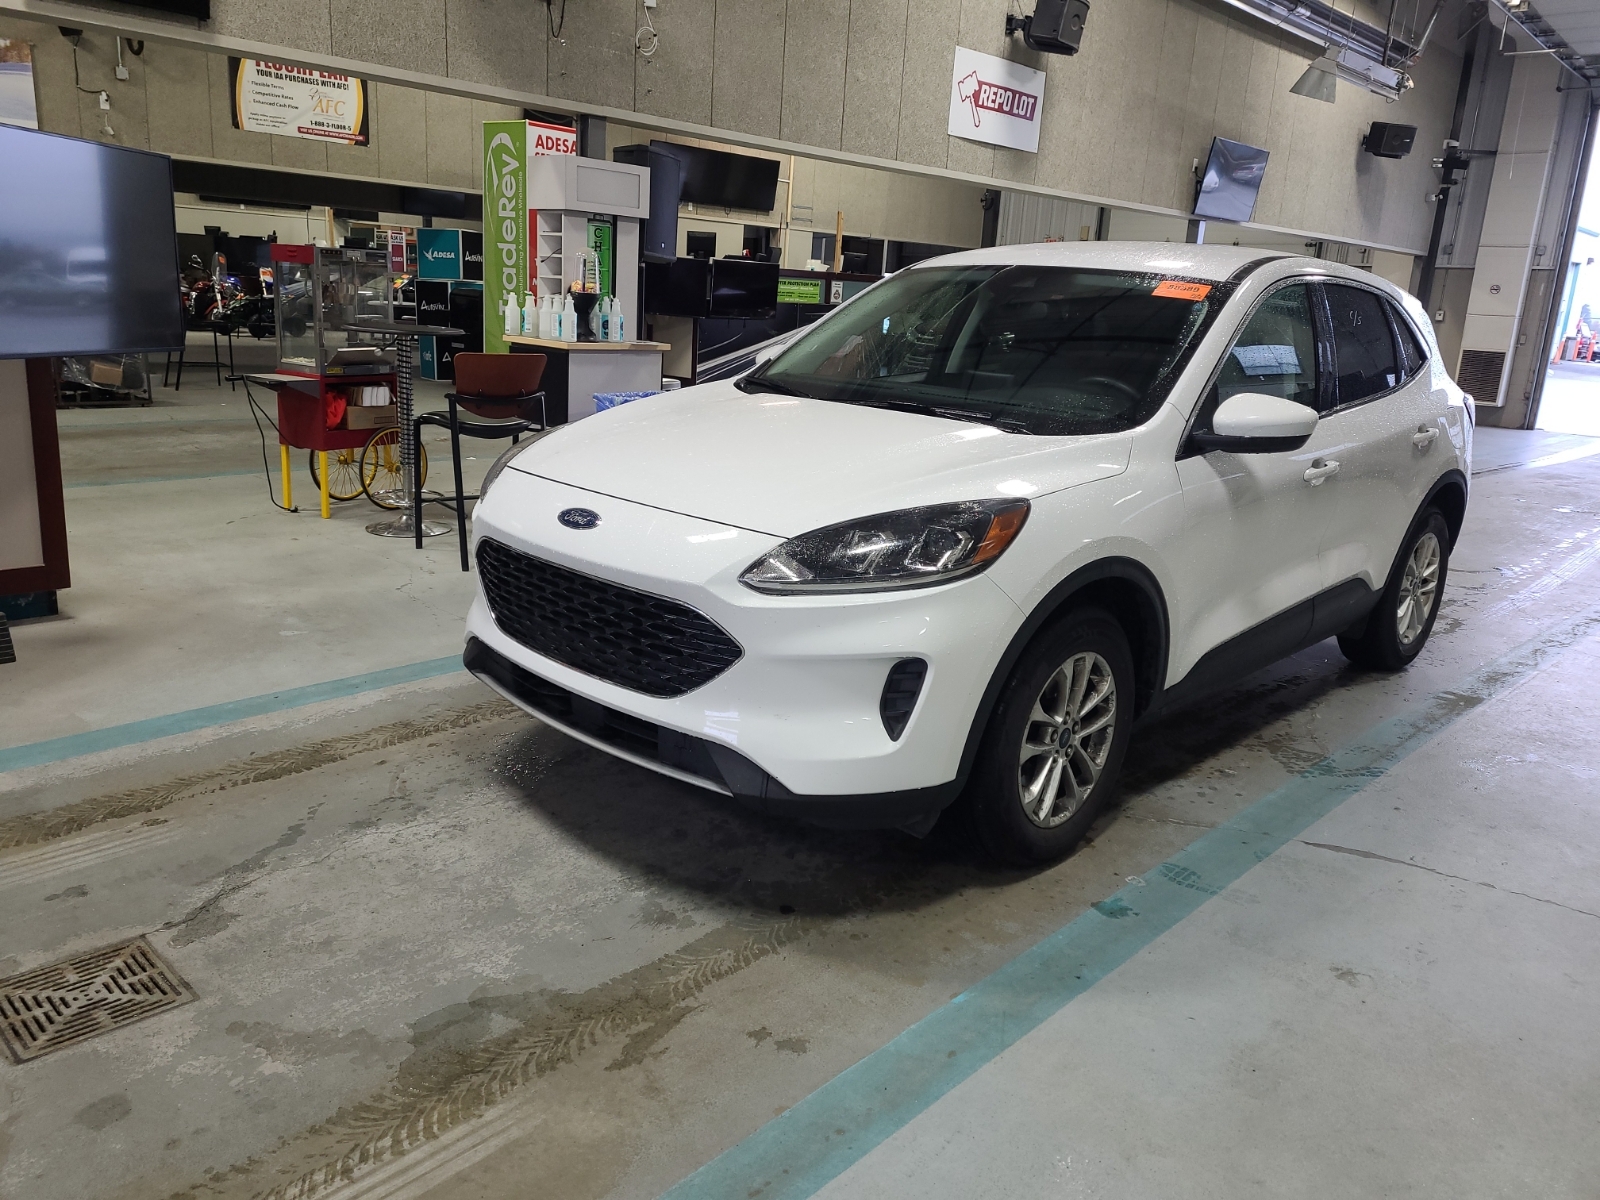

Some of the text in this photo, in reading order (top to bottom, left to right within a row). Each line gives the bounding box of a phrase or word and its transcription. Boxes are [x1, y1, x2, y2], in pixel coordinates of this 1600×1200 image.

[256, 68, 273, 78] YOUR
[274, 72, 284, 80] IAA
[285, 73, 319, 86] PURCHASES
[320, 80, 336, 89] WITH
[336, 82, 349, 91] AFC!
[252, 89, 280, 99] Competitive
[253, 98, 275, 107] Enhanced
[979, 84, 1034, 117] REPO LOT
[312, 99, 346, 117] AFC
[535, 134, 577, 154] ADESA
[433, 250, 455, 259] ADESA
